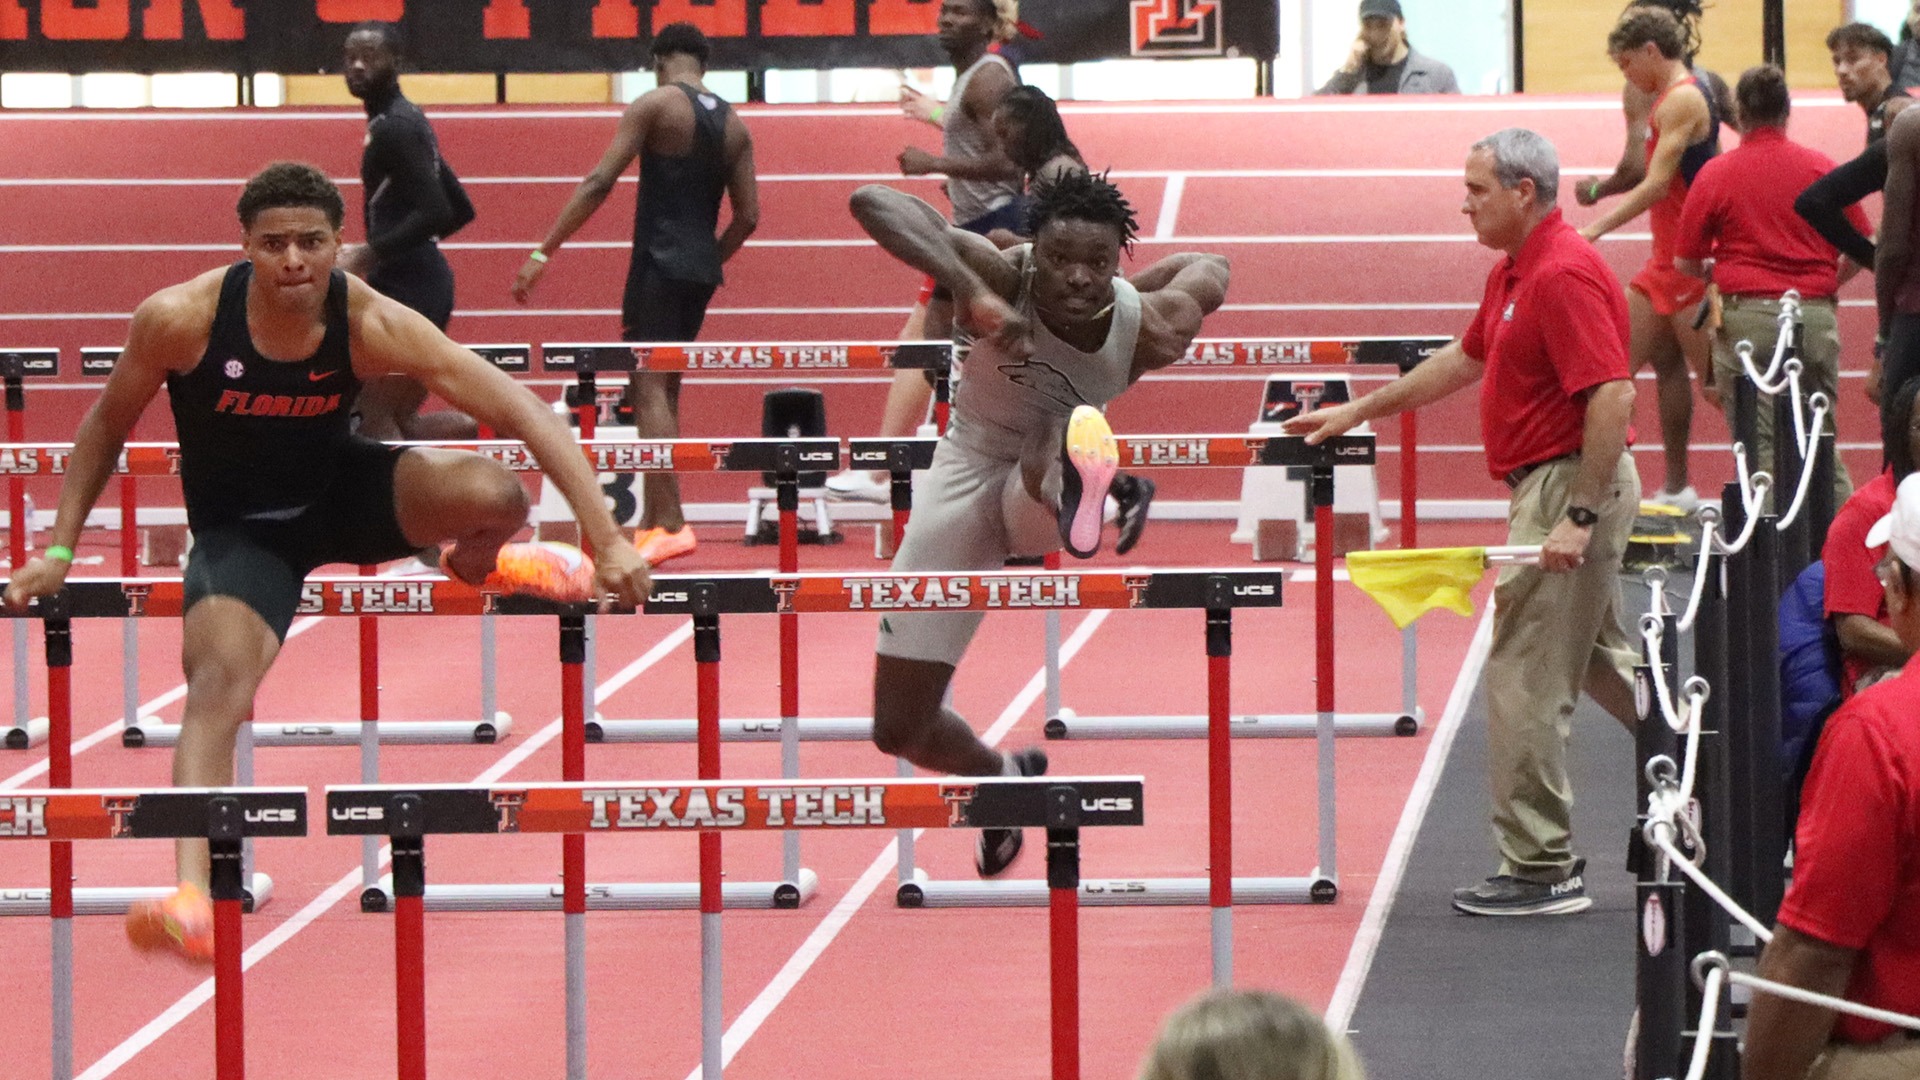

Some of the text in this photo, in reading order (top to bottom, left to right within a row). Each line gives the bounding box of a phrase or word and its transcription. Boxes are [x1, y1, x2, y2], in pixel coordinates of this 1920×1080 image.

[683, 346, 848, 369] TEXAS TECH
[1241, 341, 1312, 364] TECH
[215, 389, 342, 417] FLORIDA
[592, 444, 674, 471] TECH
[799, 451, 834, 462] UCS
[852, 451, 888, 462] UCS
[1127, 439, 1210, 465] TECH
[333, 582, 434, 613] TECH
[842, 575, 1081, 609] TEXAS TECH
[1233, 584, 1275, 596] UCS
[244, 808, 297, 822] UCS
[332, 806, 385, 821] UCS
[582, 786, 886, 828] TEXAS TECH
[1081, 797, 1134, 812] UCS
[1551, 875, 1584, 896] HOKA
